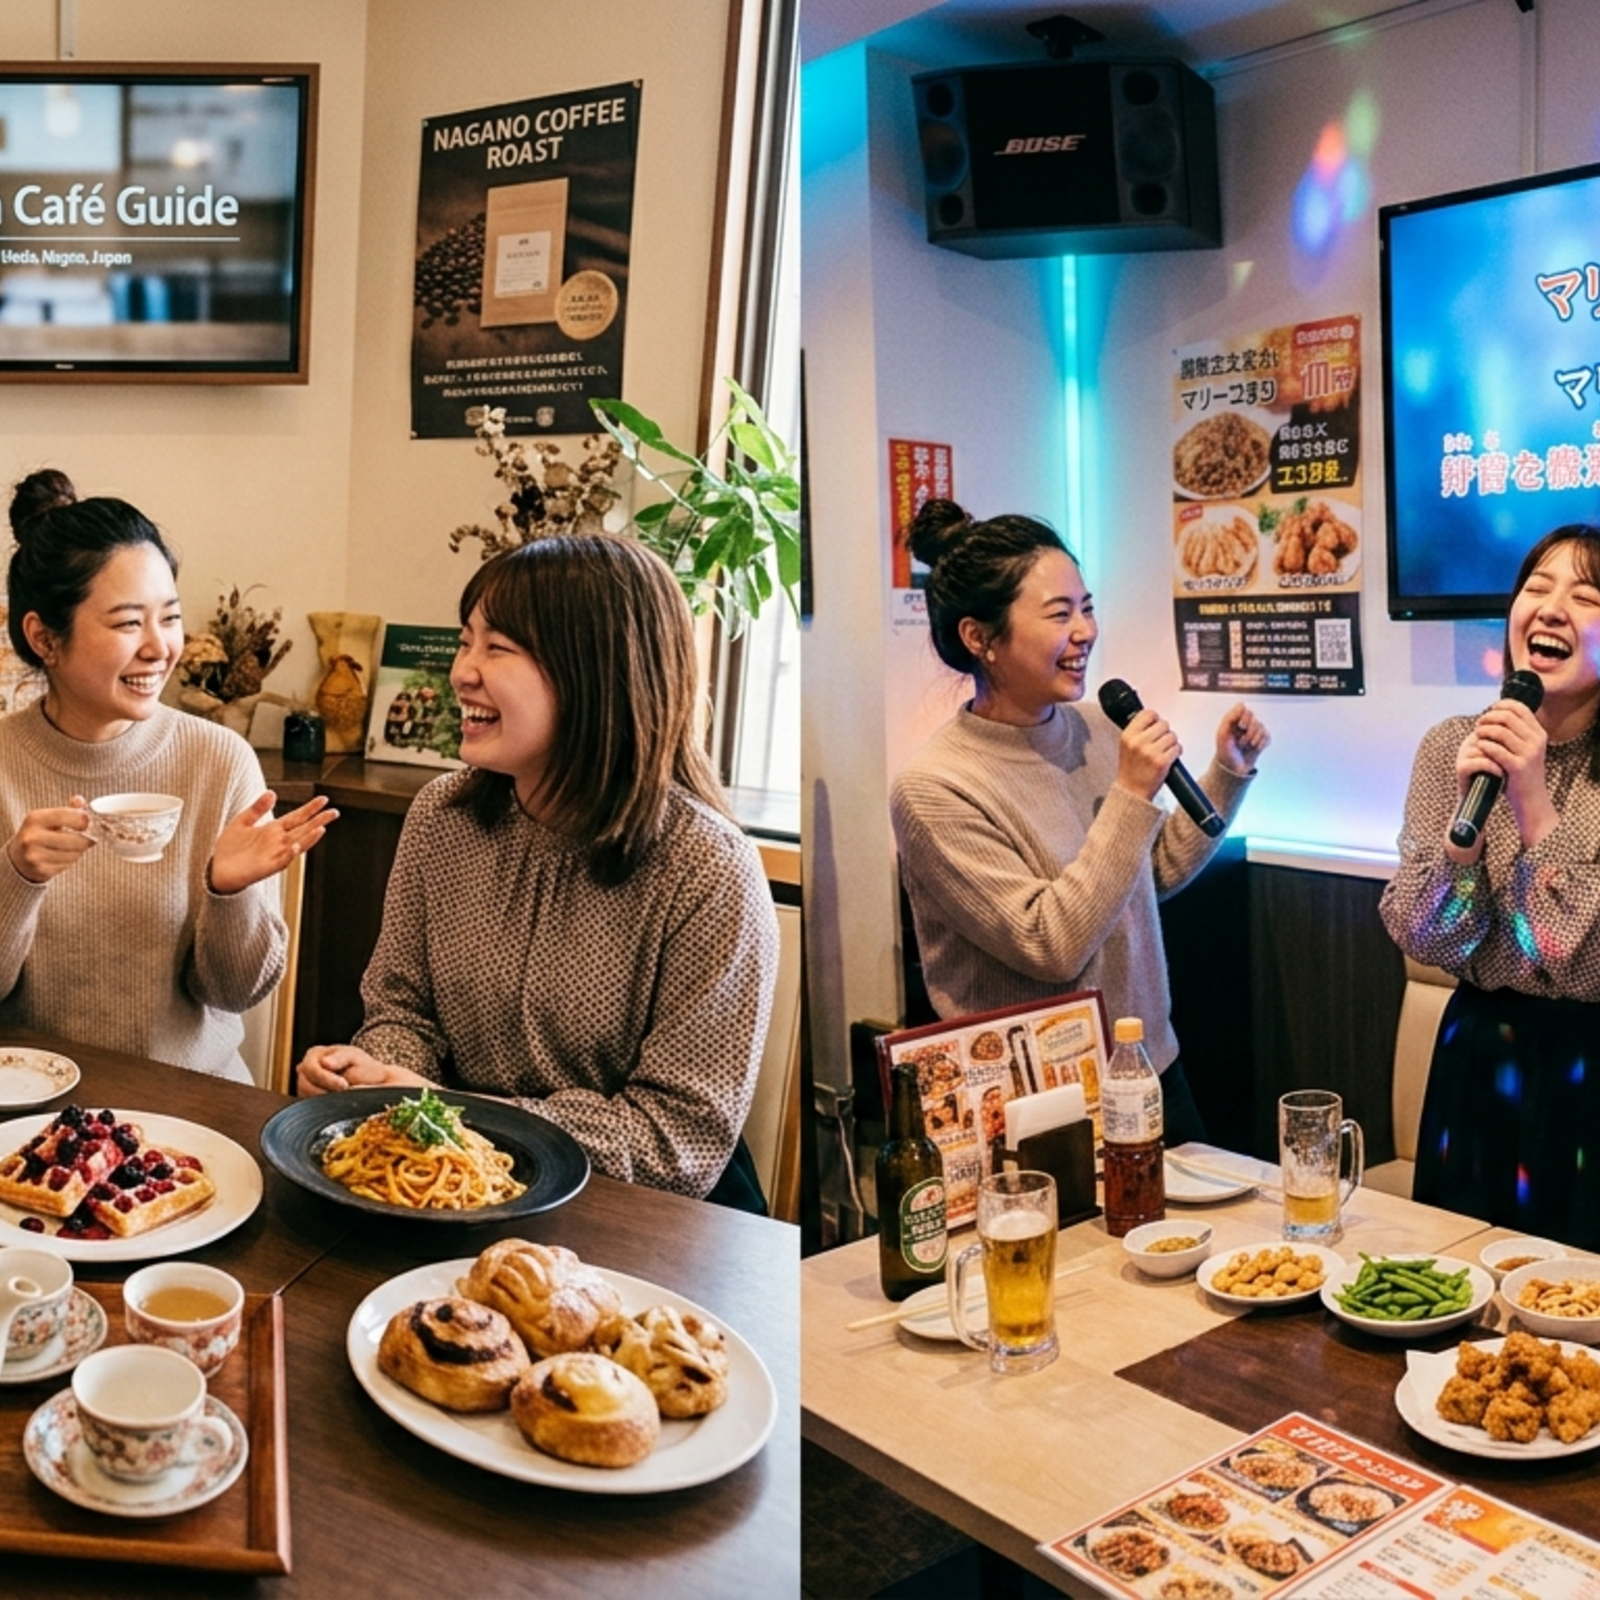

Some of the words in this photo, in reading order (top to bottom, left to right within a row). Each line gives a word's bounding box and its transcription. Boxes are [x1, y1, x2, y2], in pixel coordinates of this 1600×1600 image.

[433, 114, 530, 152] NAGANO
[535, 98, 627, 135] COFFEE
[486, 136, 564, 170] ROAST
[13, 183, 106, 226] Café
[116, 184, 240, 226] Guide
[1555, 363, 1600, 411] マ
